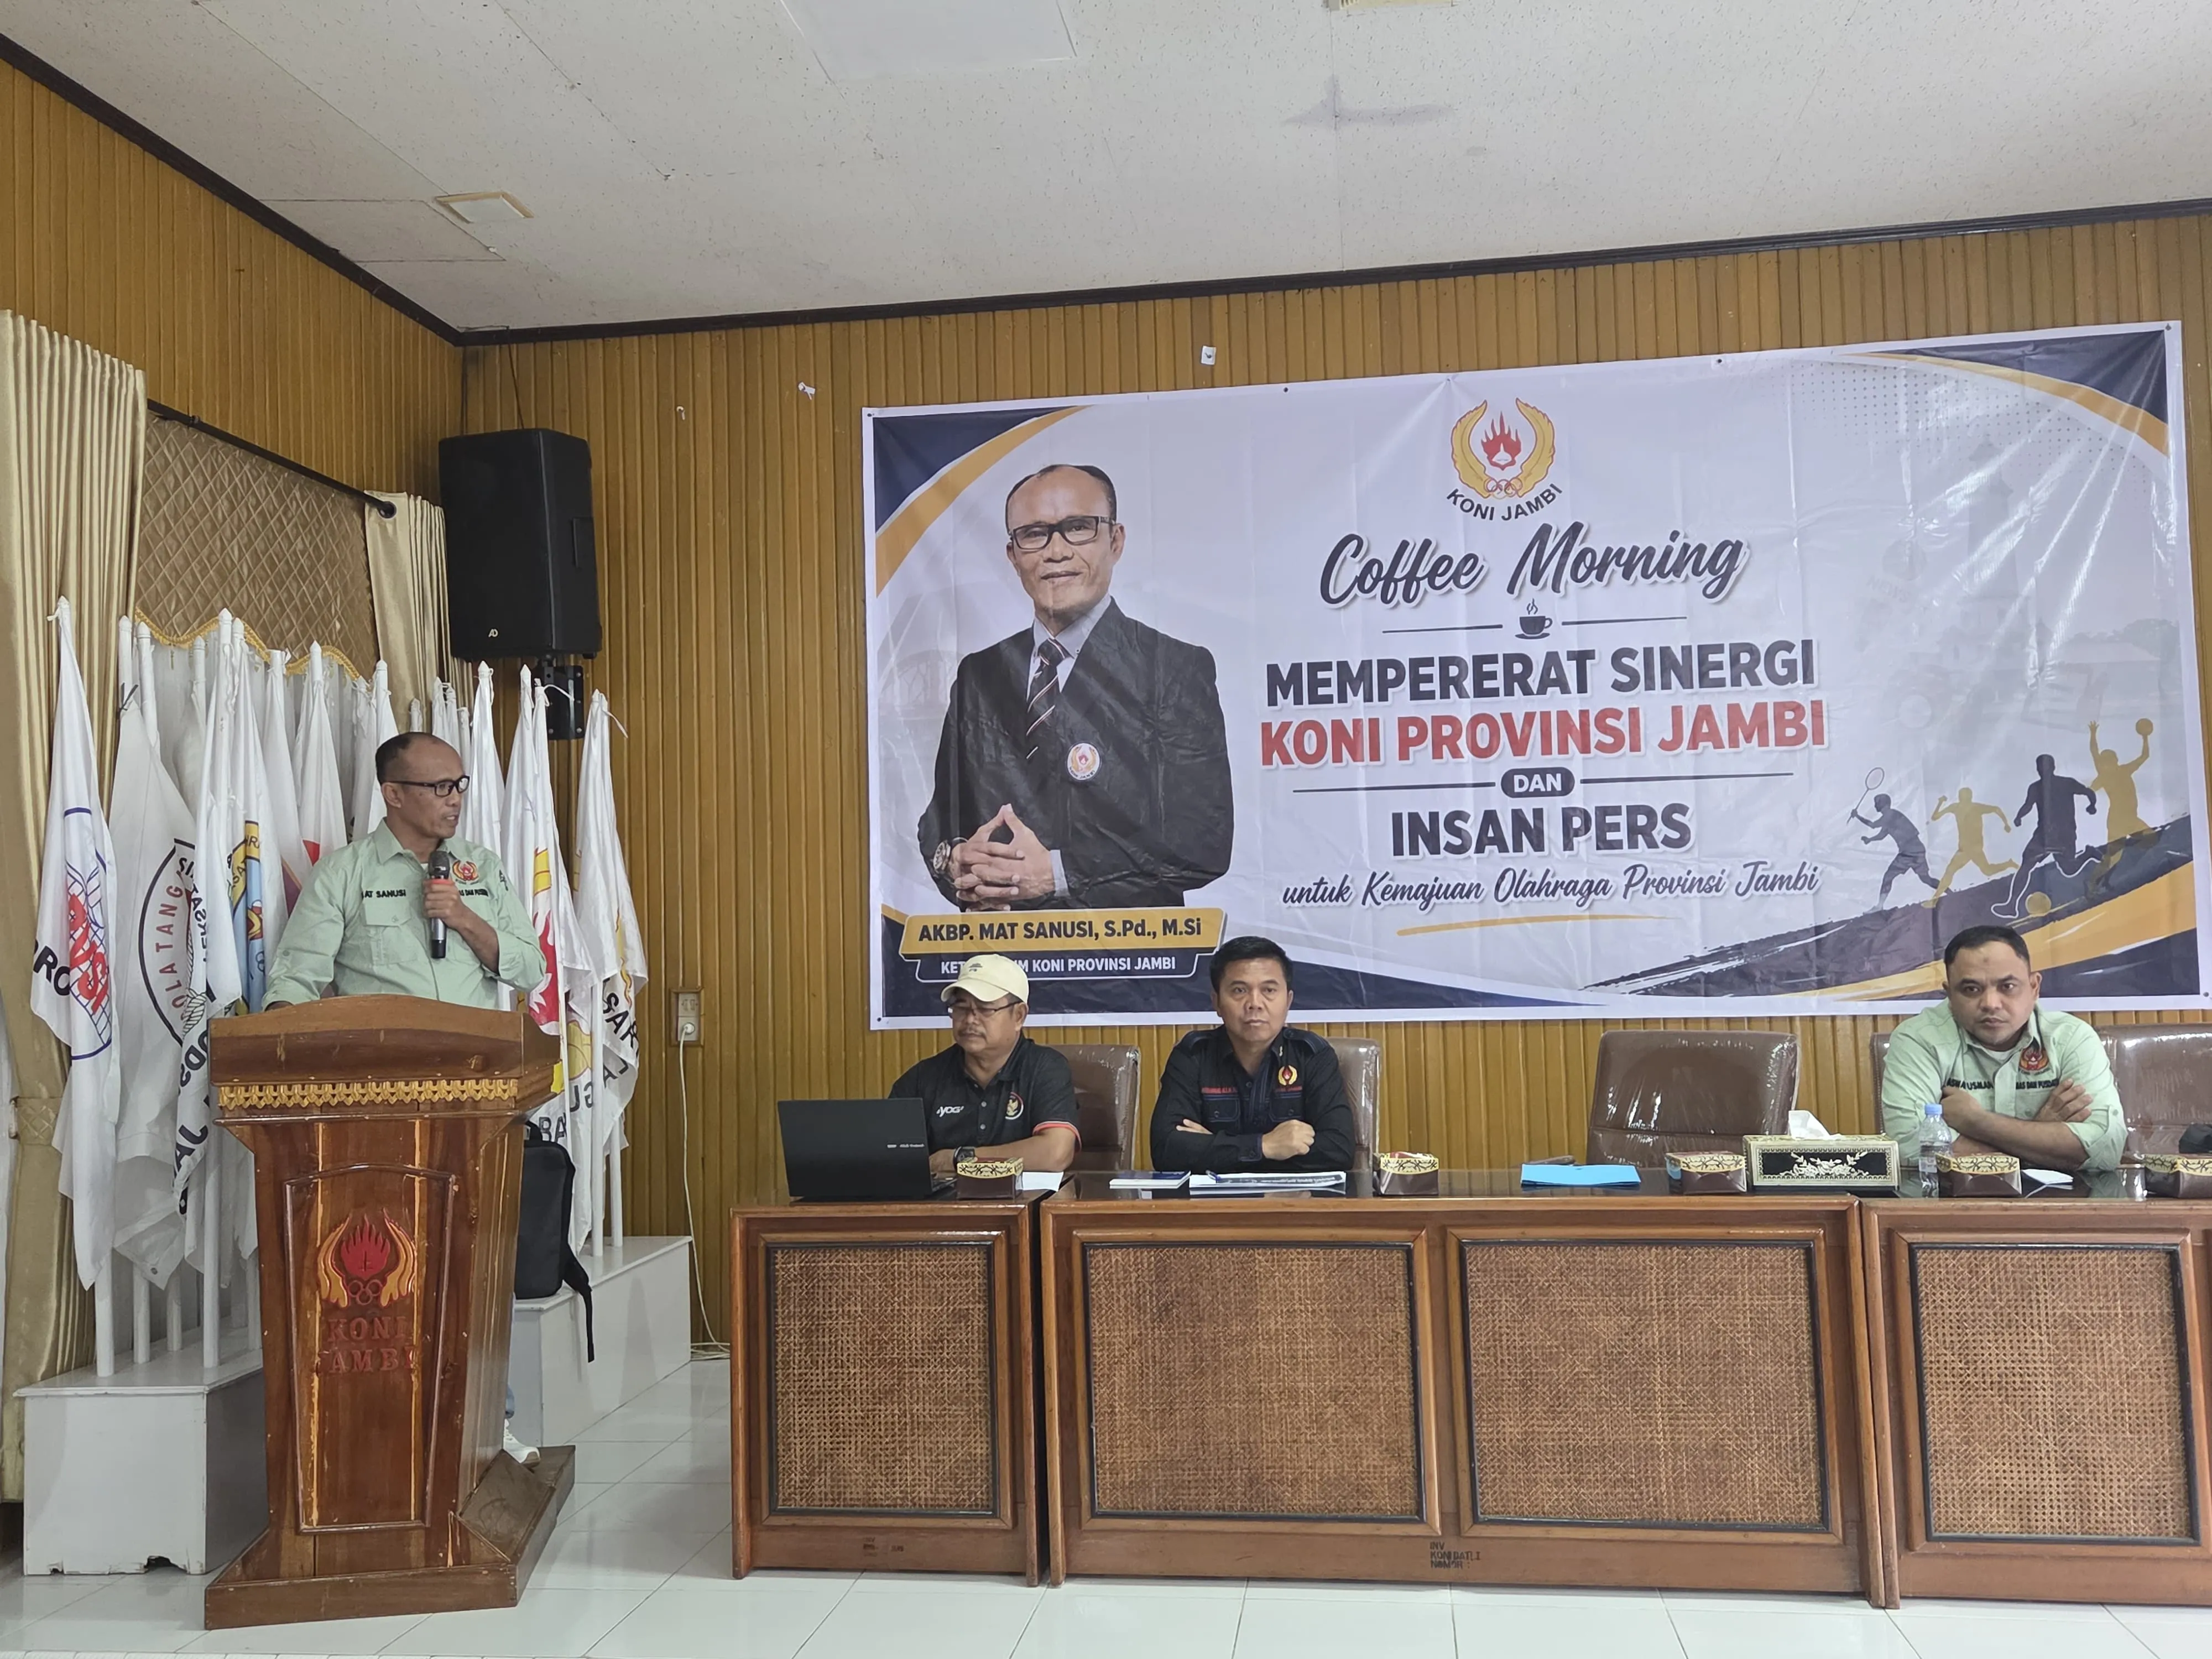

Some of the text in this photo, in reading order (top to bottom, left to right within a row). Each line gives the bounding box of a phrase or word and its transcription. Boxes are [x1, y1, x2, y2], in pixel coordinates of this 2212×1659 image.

[1446, 483, 1563, 521] KONI JAMBI
[1321, 521, 1743, 608] Coffee Morning
[1266, 639, 1814, 706] MEMPERERAT SINERGI
[1261, 701, 1824, 765] KONI PROVINSI JAMBI
[1514, 773, 1562, 792] DAN
[1392, 804, 1691, 857] INSAN PERS
[376, 889, 406, 898] SANUSI
[1282, 861, 1819, 911] untuk Kemajuan Olahraga Provinsi Jambi
[919, 917, 1201, 941] AKBP. MAT SANUSI, S.Pd., M.Si
[941, 961, 966, 974] KET
[1032, 959, 1065, 972] KONI
[1068, 957, 1131, 972] PROVINSI
[1134, 956, 1176, 970] JAMBI
[327, 1316, 407, 1342] KONI
[328, 1345, 415, 1374] AMBI
